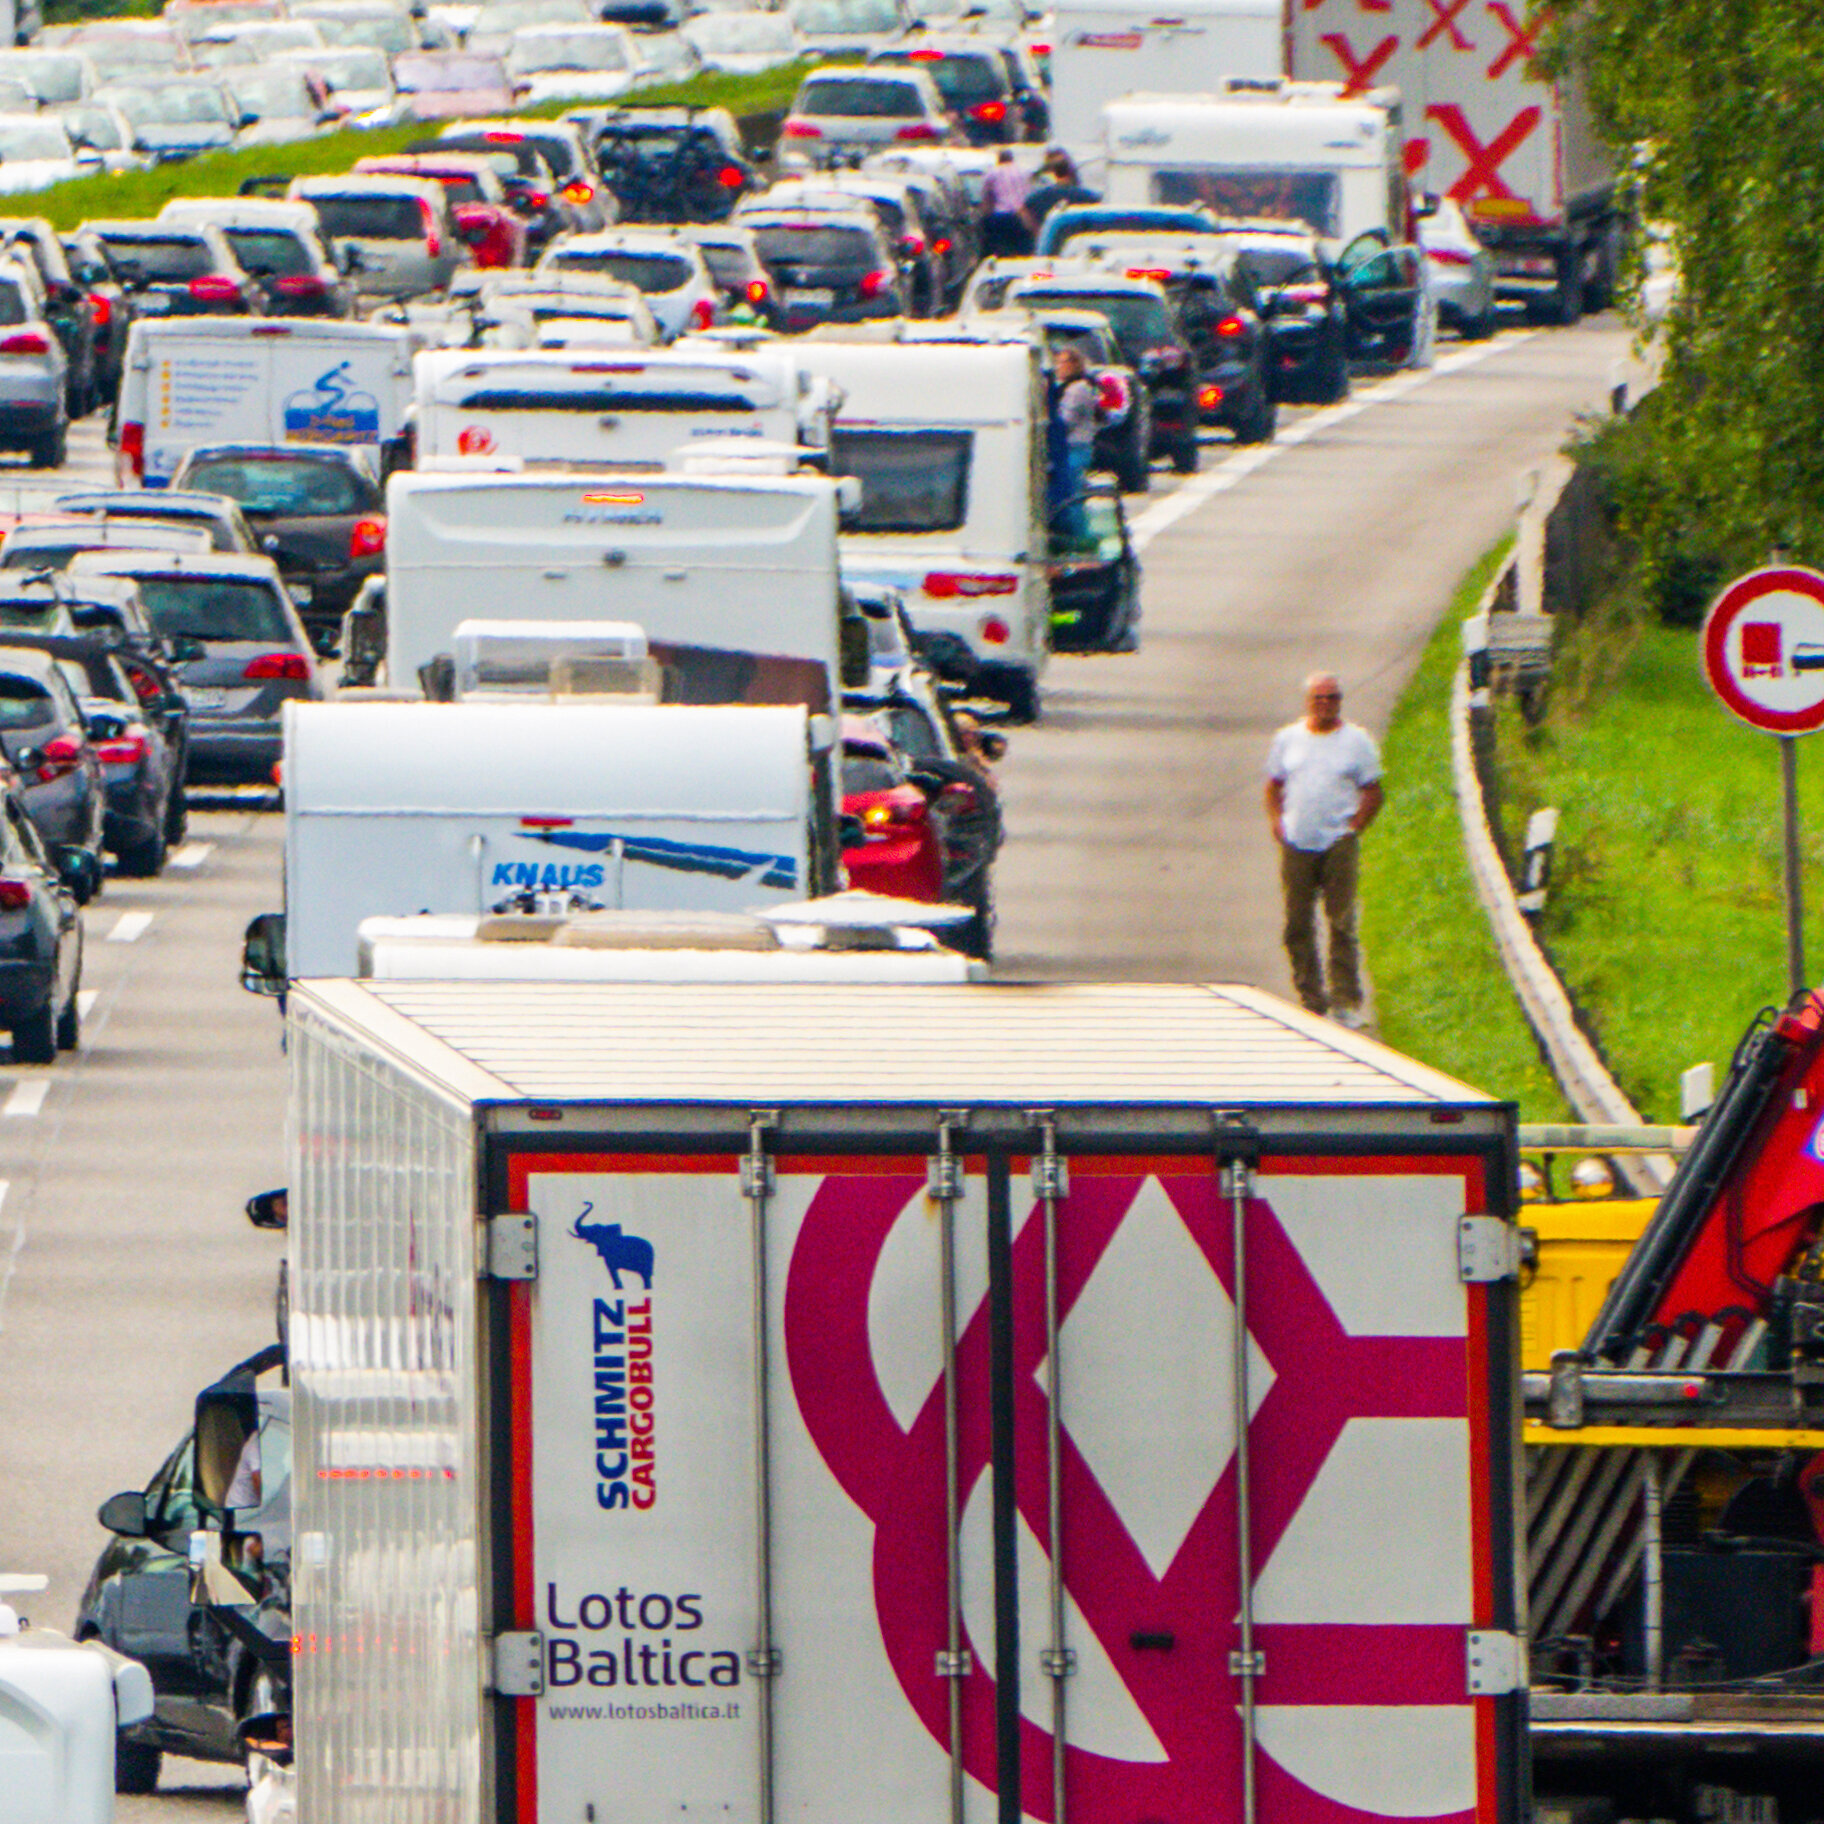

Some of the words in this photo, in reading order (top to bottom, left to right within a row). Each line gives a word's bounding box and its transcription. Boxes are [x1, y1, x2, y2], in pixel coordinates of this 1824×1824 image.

[492, 862, 605, 887] KNAUS
[593, 1298, 629, 1509] SCHMITZ
[628, 1297, 656, 1510] CARGOBULL
[548, 1582, 704, 1631] Lotos
[548, 1637, 741, 1687] Baltica
[548, 1703, 741, 1720] www.lotosbaltica.lt
